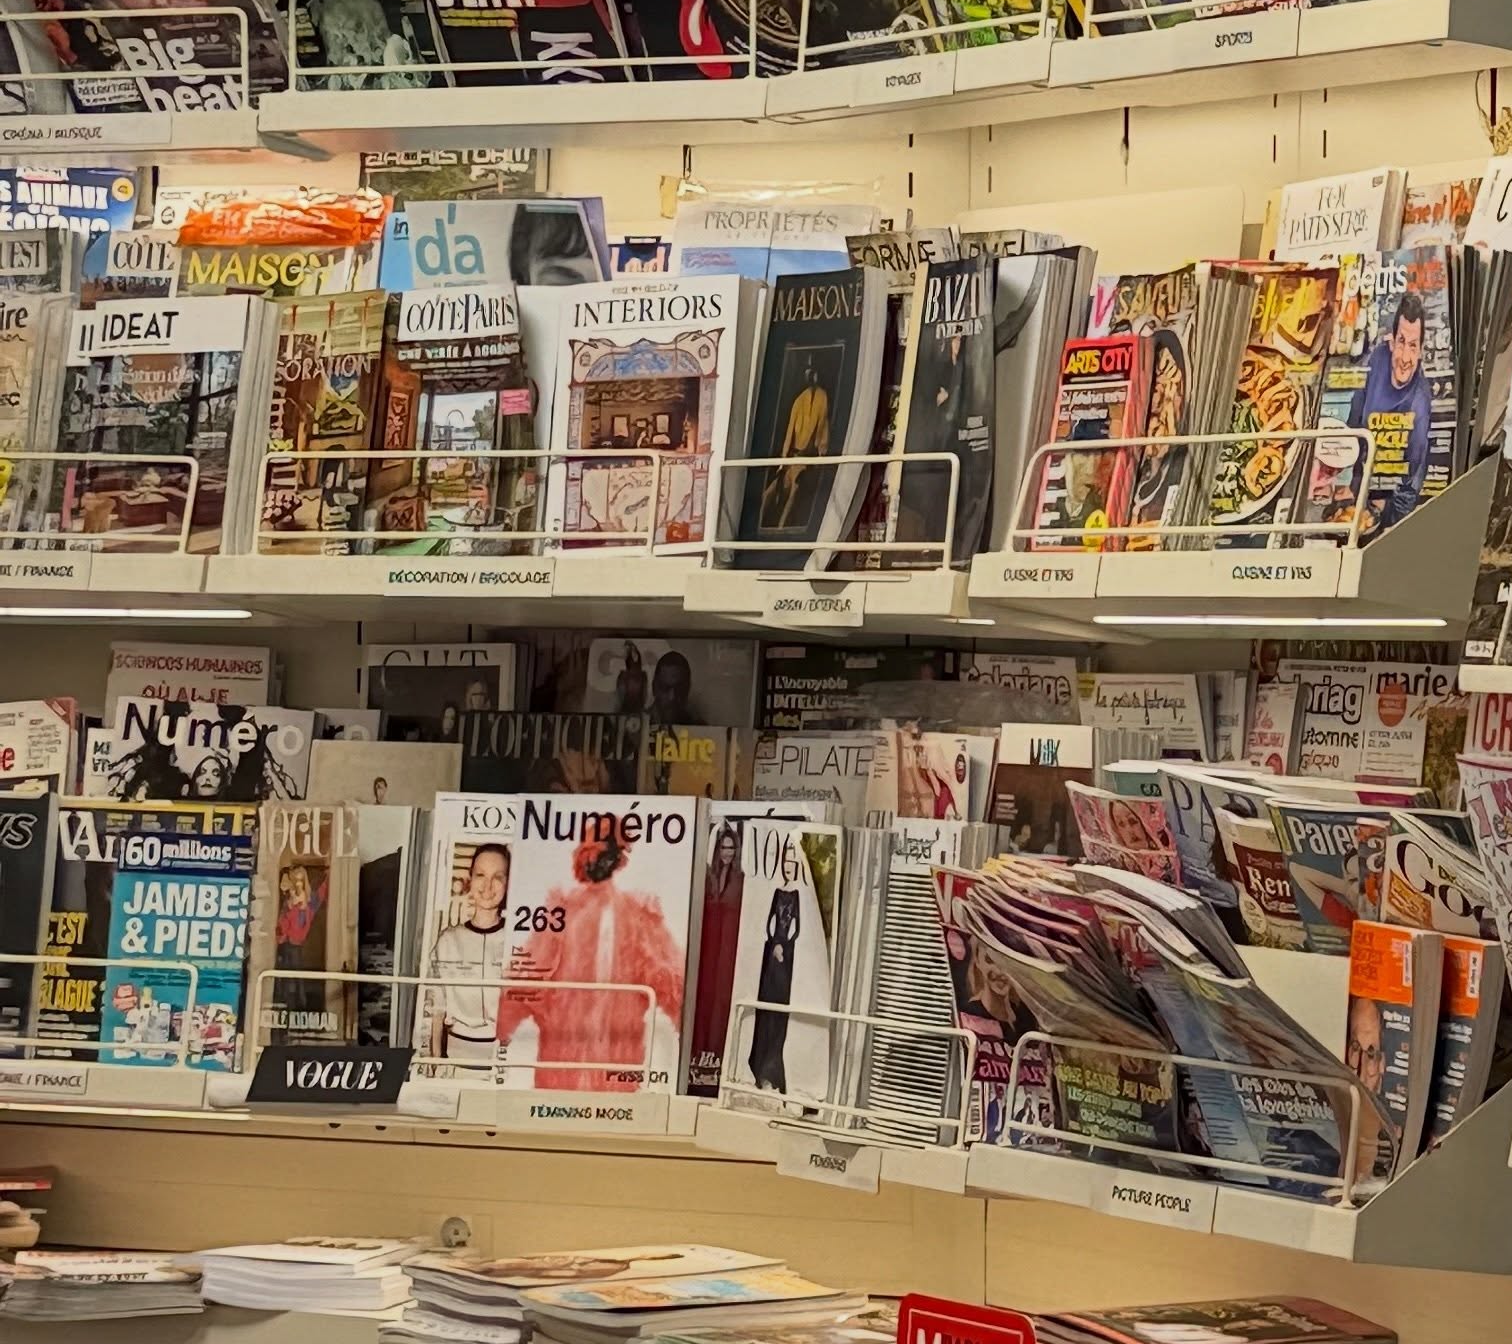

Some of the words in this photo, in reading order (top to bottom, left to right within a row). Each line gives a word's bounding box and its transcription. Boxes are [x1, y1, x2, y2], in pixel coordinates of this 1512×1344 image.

[116, 29, 197, 86] Big
[101, 310, 180, 344] IDEAT
[572, 292, 724, 329] INTERIORS
[123, 700, 306, 754] Numéro
[521, 799, 687, 844] Numéro
[125, 836, 160, 868] 60
[161, 841, 233, 865] millions
[121, 921, 148, 954] &
[512, 906, 566, 935] 263
[285, 1058, 384, 1092] VOGUE
